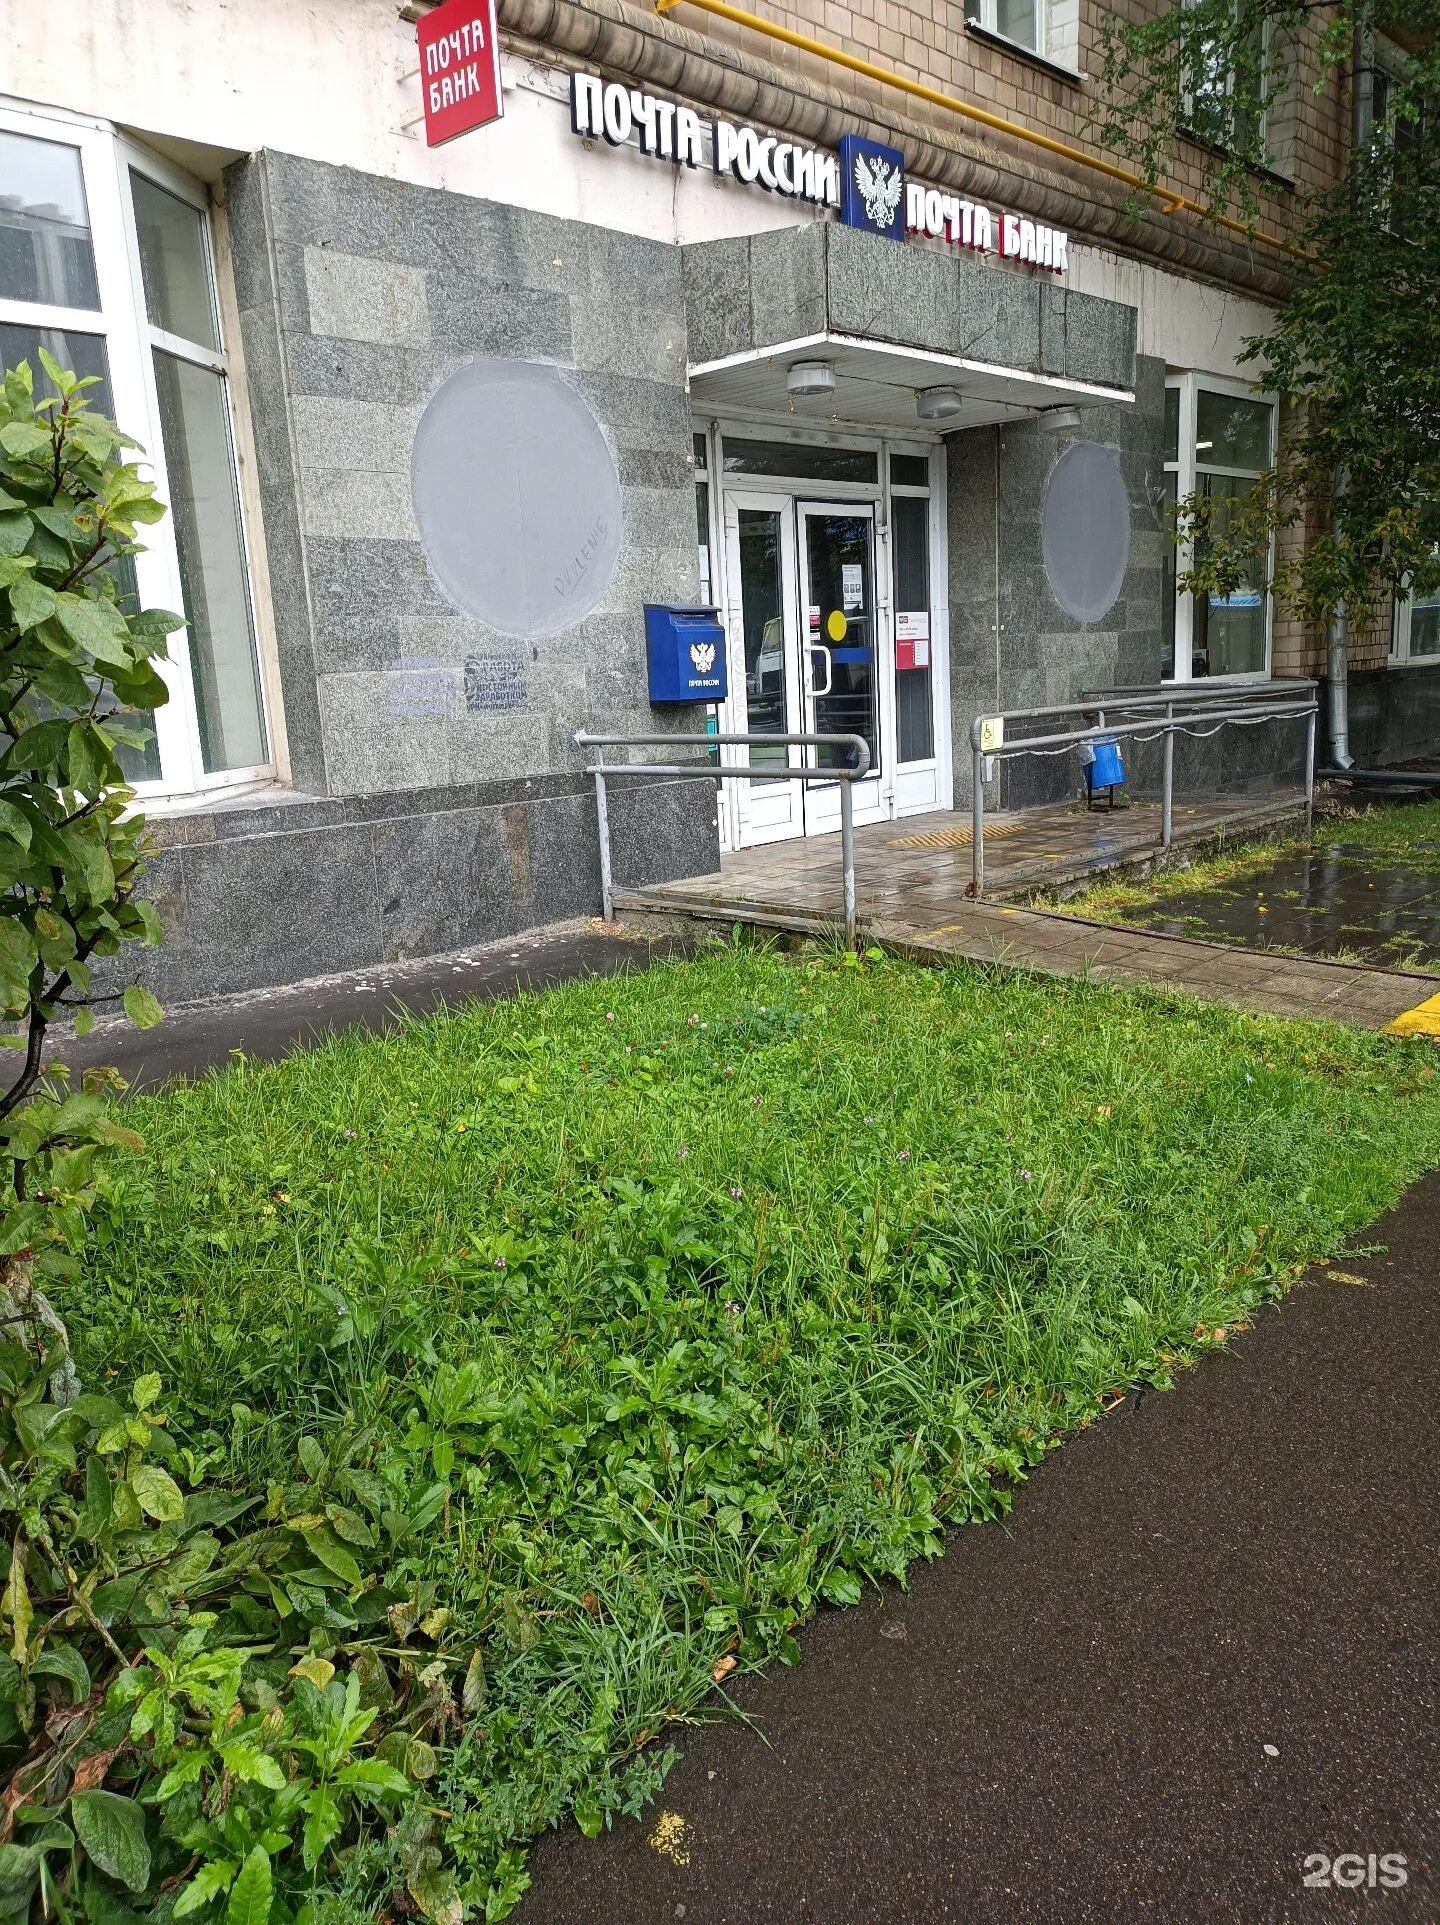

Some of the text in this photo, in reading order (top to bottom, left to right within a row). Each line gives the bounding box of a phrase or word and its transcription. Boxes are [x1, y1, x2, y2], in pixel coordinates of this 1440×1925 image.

[426, 19, 485, 76] ПОЧТА
[429, 62, 481, 114] БАНК
[571, 72, 837, 207] ПОЧТА РОССИИ
[905, 183, 1069, 275] ПОЧТА БАНК
